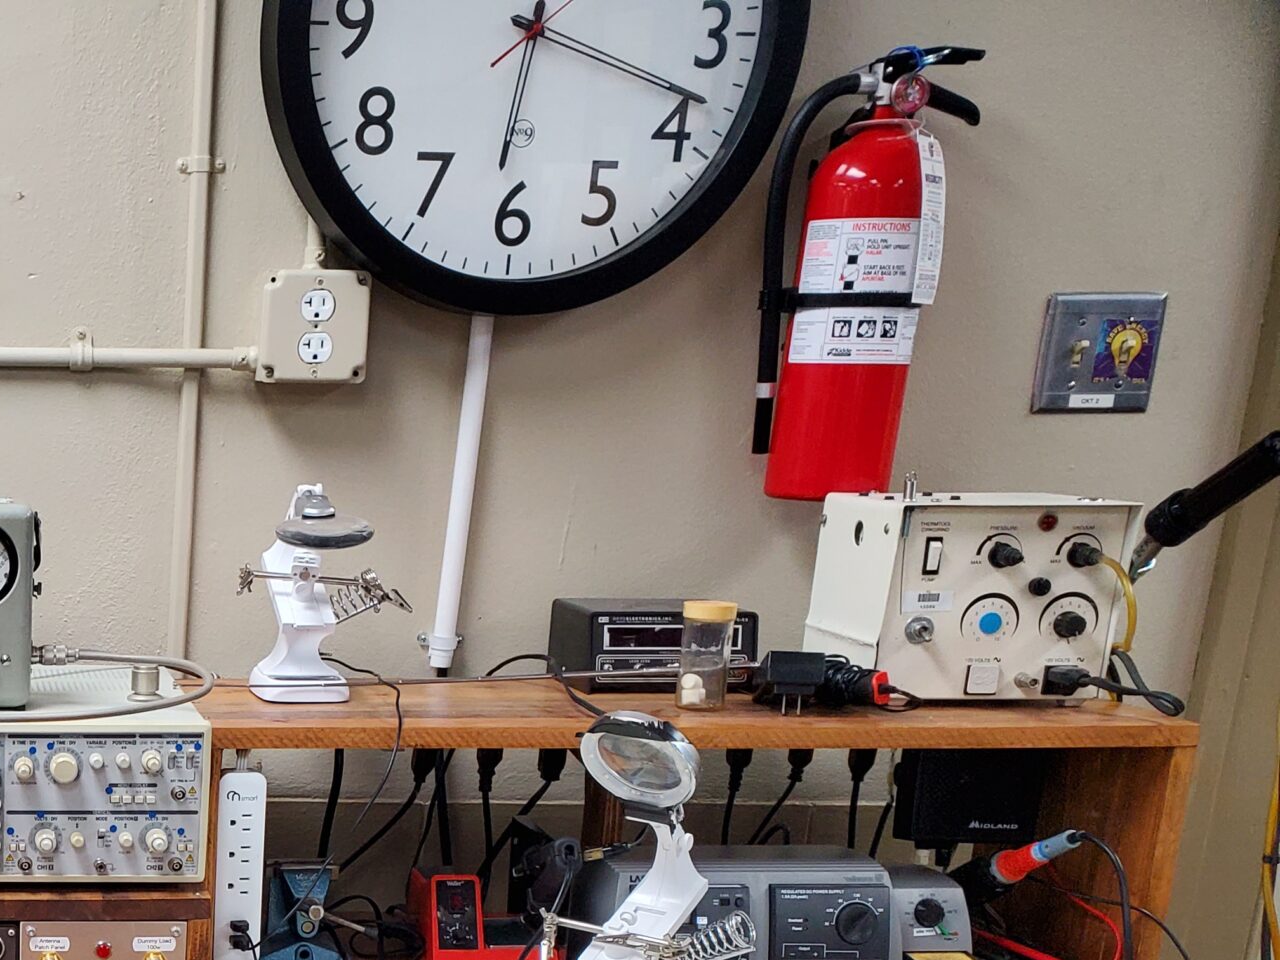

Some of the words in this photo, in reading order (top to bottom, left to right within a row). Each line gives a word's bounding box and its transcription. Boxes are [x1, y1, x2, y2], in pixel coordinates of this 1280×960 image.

[336, 0, 374, 59] 9
[694, 0, 730, 69] 3
[355, 86, 395, 155] 8
[651, 96, 691, 162] 4
[417, 152, 455, 217] 7
[495, 181, 531, 246] 6
[581, 161, 618, 226] 5
[852, 222, 912, 231] INSTRUCTIONS
[969, 820, 1018, 829] MIDLAND
